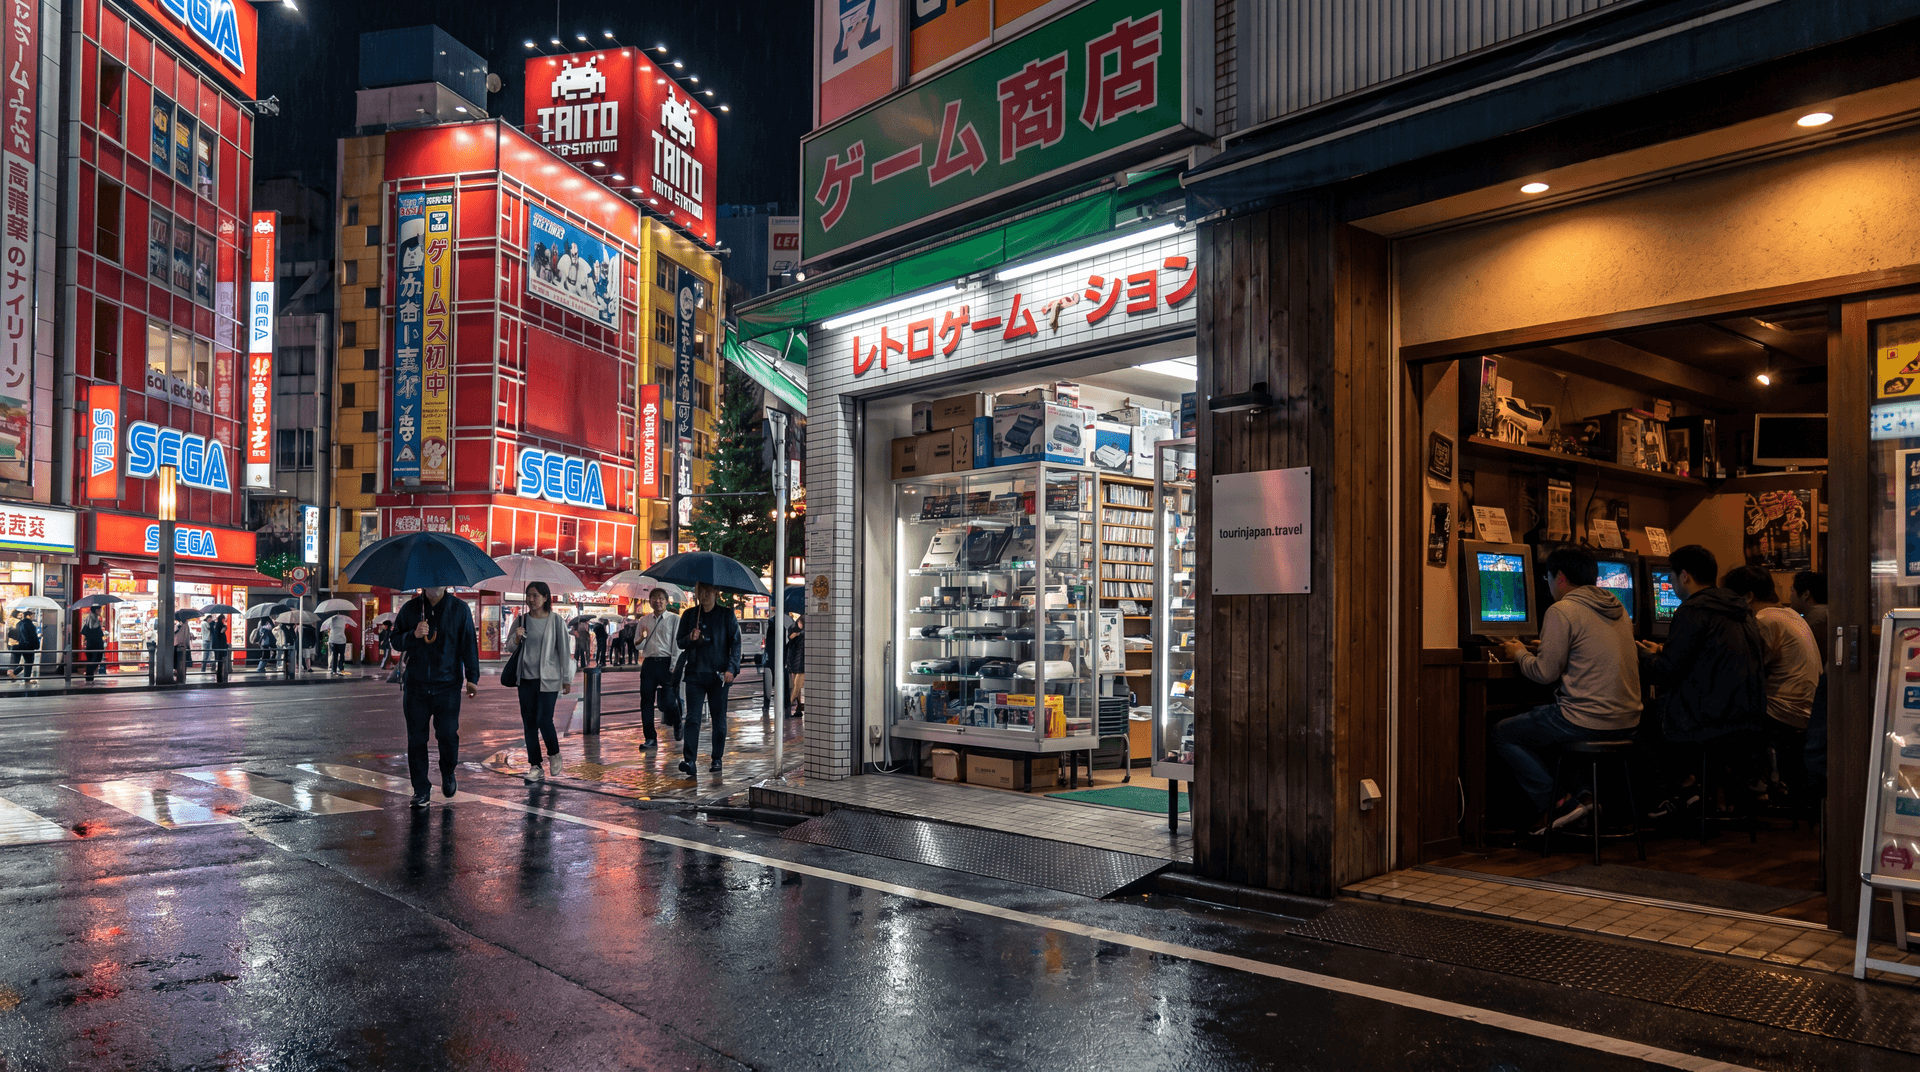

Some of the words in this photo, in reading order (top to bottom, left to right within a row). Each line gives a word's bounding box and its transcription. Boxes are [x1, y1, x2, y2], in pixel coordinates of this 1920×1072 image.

[537, 101, 619, 143] TAITO
[815, 9, 1163, 232] ゲーム商店
[571, 139, 618, 156] STATION
[651, 129, 703, 204] TAITO
[651, 174, 674, 202] TAITO
[91, 407, 116, 478] SEGA
[126, 420, 232, 494] SEGA
[517, 447, 607, 510] SEGA
[145, 523, 218, 559] SEGA
[1219, 523, 1303, 541] tourinjapan.travel
